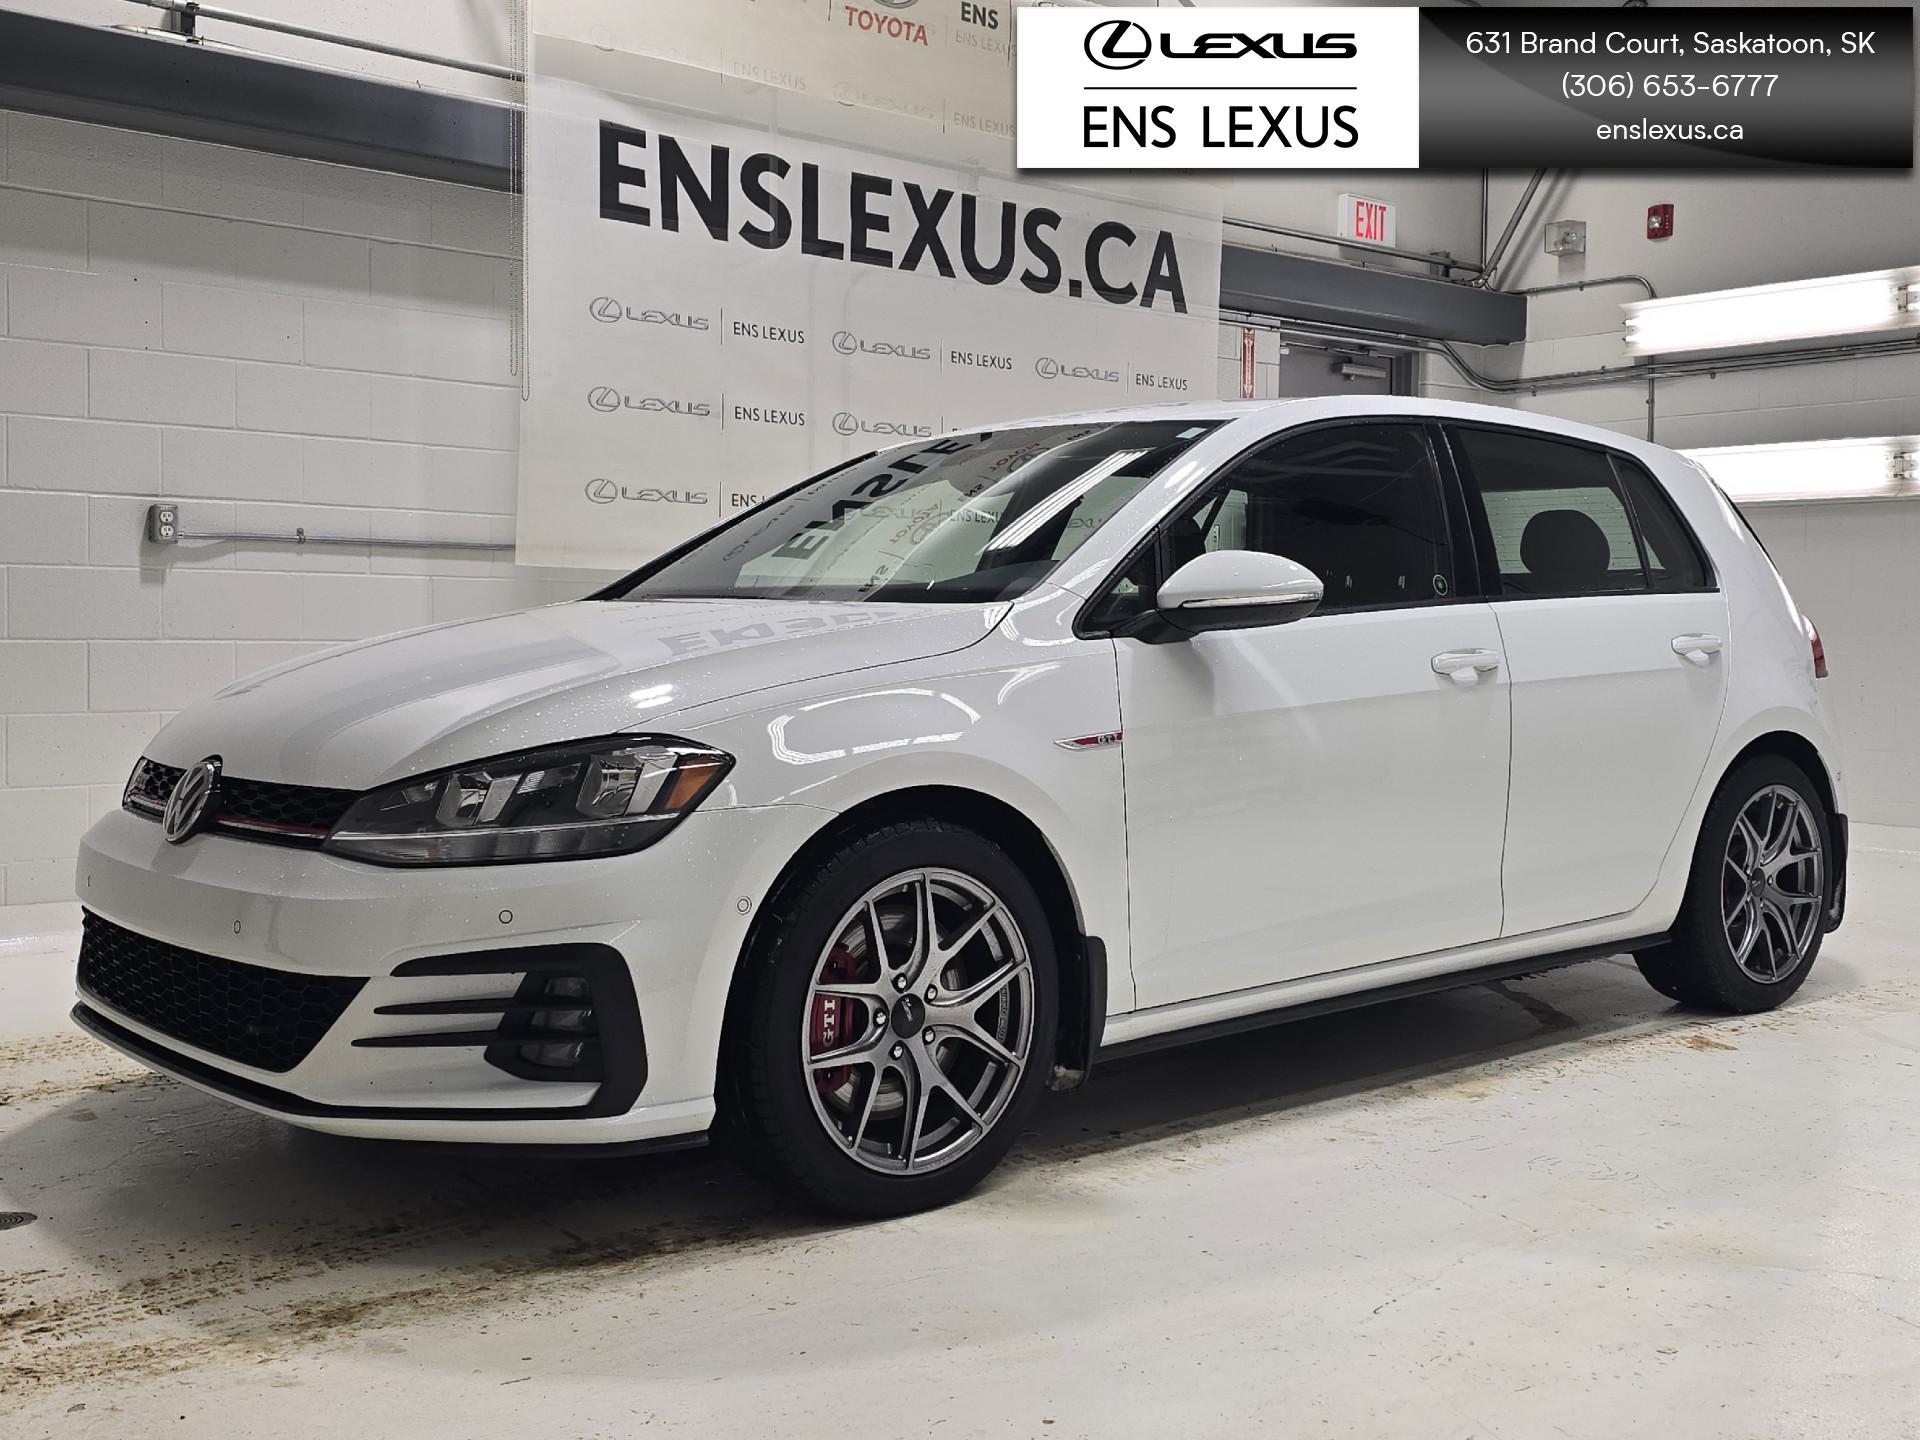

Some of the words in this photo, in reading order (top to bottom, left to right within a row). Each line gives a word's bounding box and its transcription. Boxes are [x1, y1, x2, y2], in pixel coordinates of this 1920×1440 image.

[845, 5, 928, 46] TOYOTA
[961, 1, 998, 29] ENS
[600, 119, 1188, 314] ENSLEXUS.CA
[1356, 201, 1387, 241] EXIT
[626, 307, 709, 330] LEXUS
[733, 321, 759, 338] ENS
[763, 326, 805, 344] LEXUS
[860, 339, 931, 360] LEXUS
[951, 350, 973, 366] ENS
[976, 353, 1012, 370] LEXUS
[1060, 364, 1119, 382] LEXUS
[1136, 373, 1154, 387] ENS
[1158, 376, 1187, 391] LEXUS
[624, 396, 710, 416] LEXUS
[734, 406, 760, 422] ENS
[764, 409, 805, 426] LEXUS
[861, 422, 932, 437] LEXUS
[622, 486, 708, 504] LEXUS
[822, 999, 835, 1048] GTI
